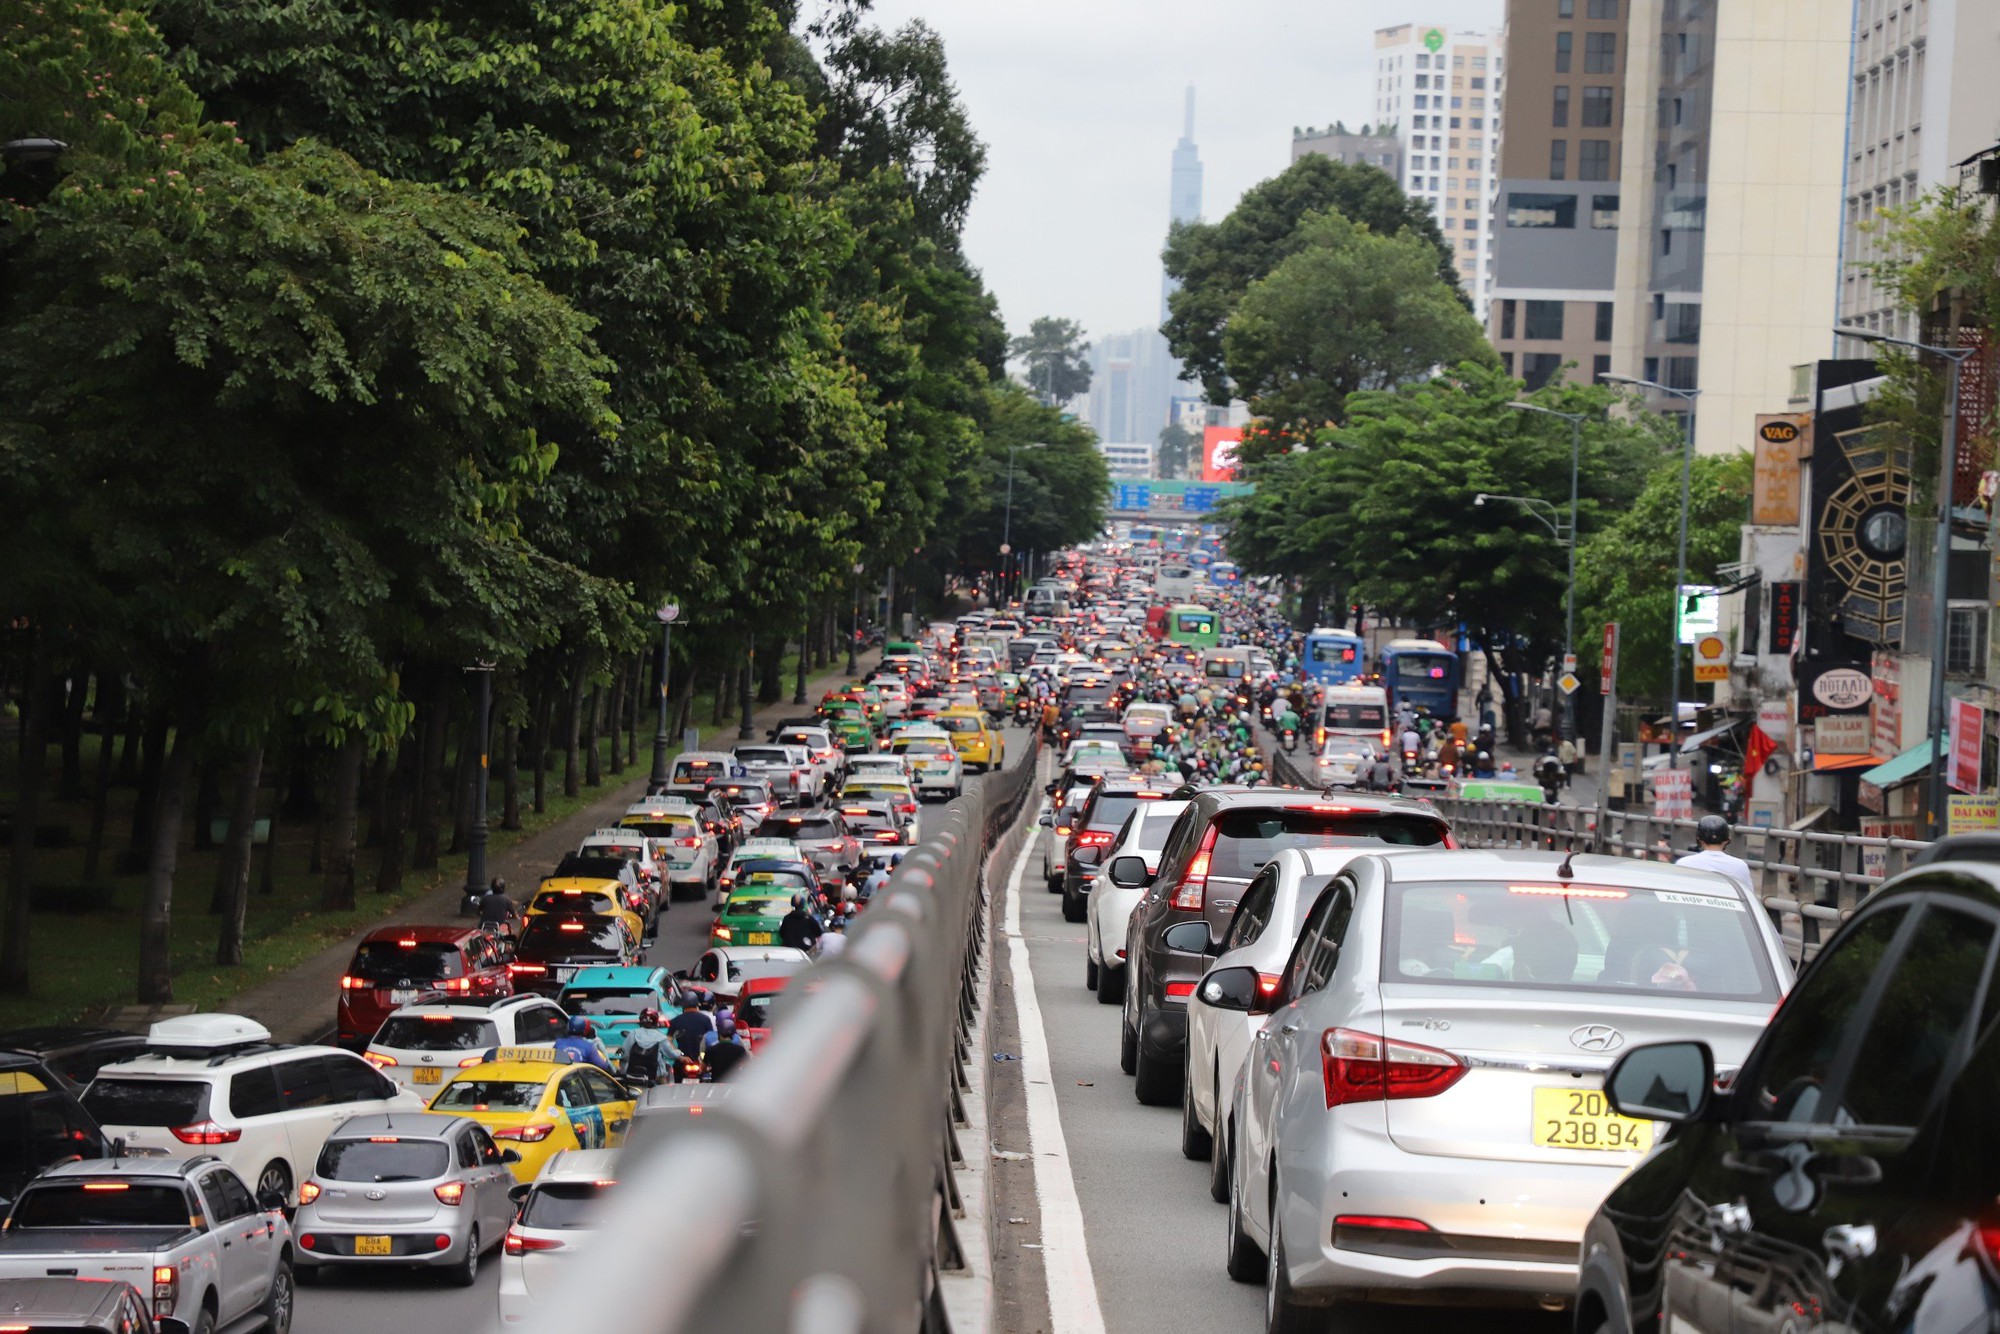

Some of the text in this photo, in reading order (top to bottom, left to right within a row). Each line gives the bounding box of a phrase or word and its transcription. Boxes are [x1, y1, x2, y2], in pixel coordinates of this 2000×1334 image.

[1764, 426, 1795, 440] VAG
[1777, 583, 1792, 647] TATTOO
[1974, 808, 1996, 818] ANH
[502, 1048, 552, 1060] 38 111 111
[1546, 1120, 1639, 1147] 238.94
